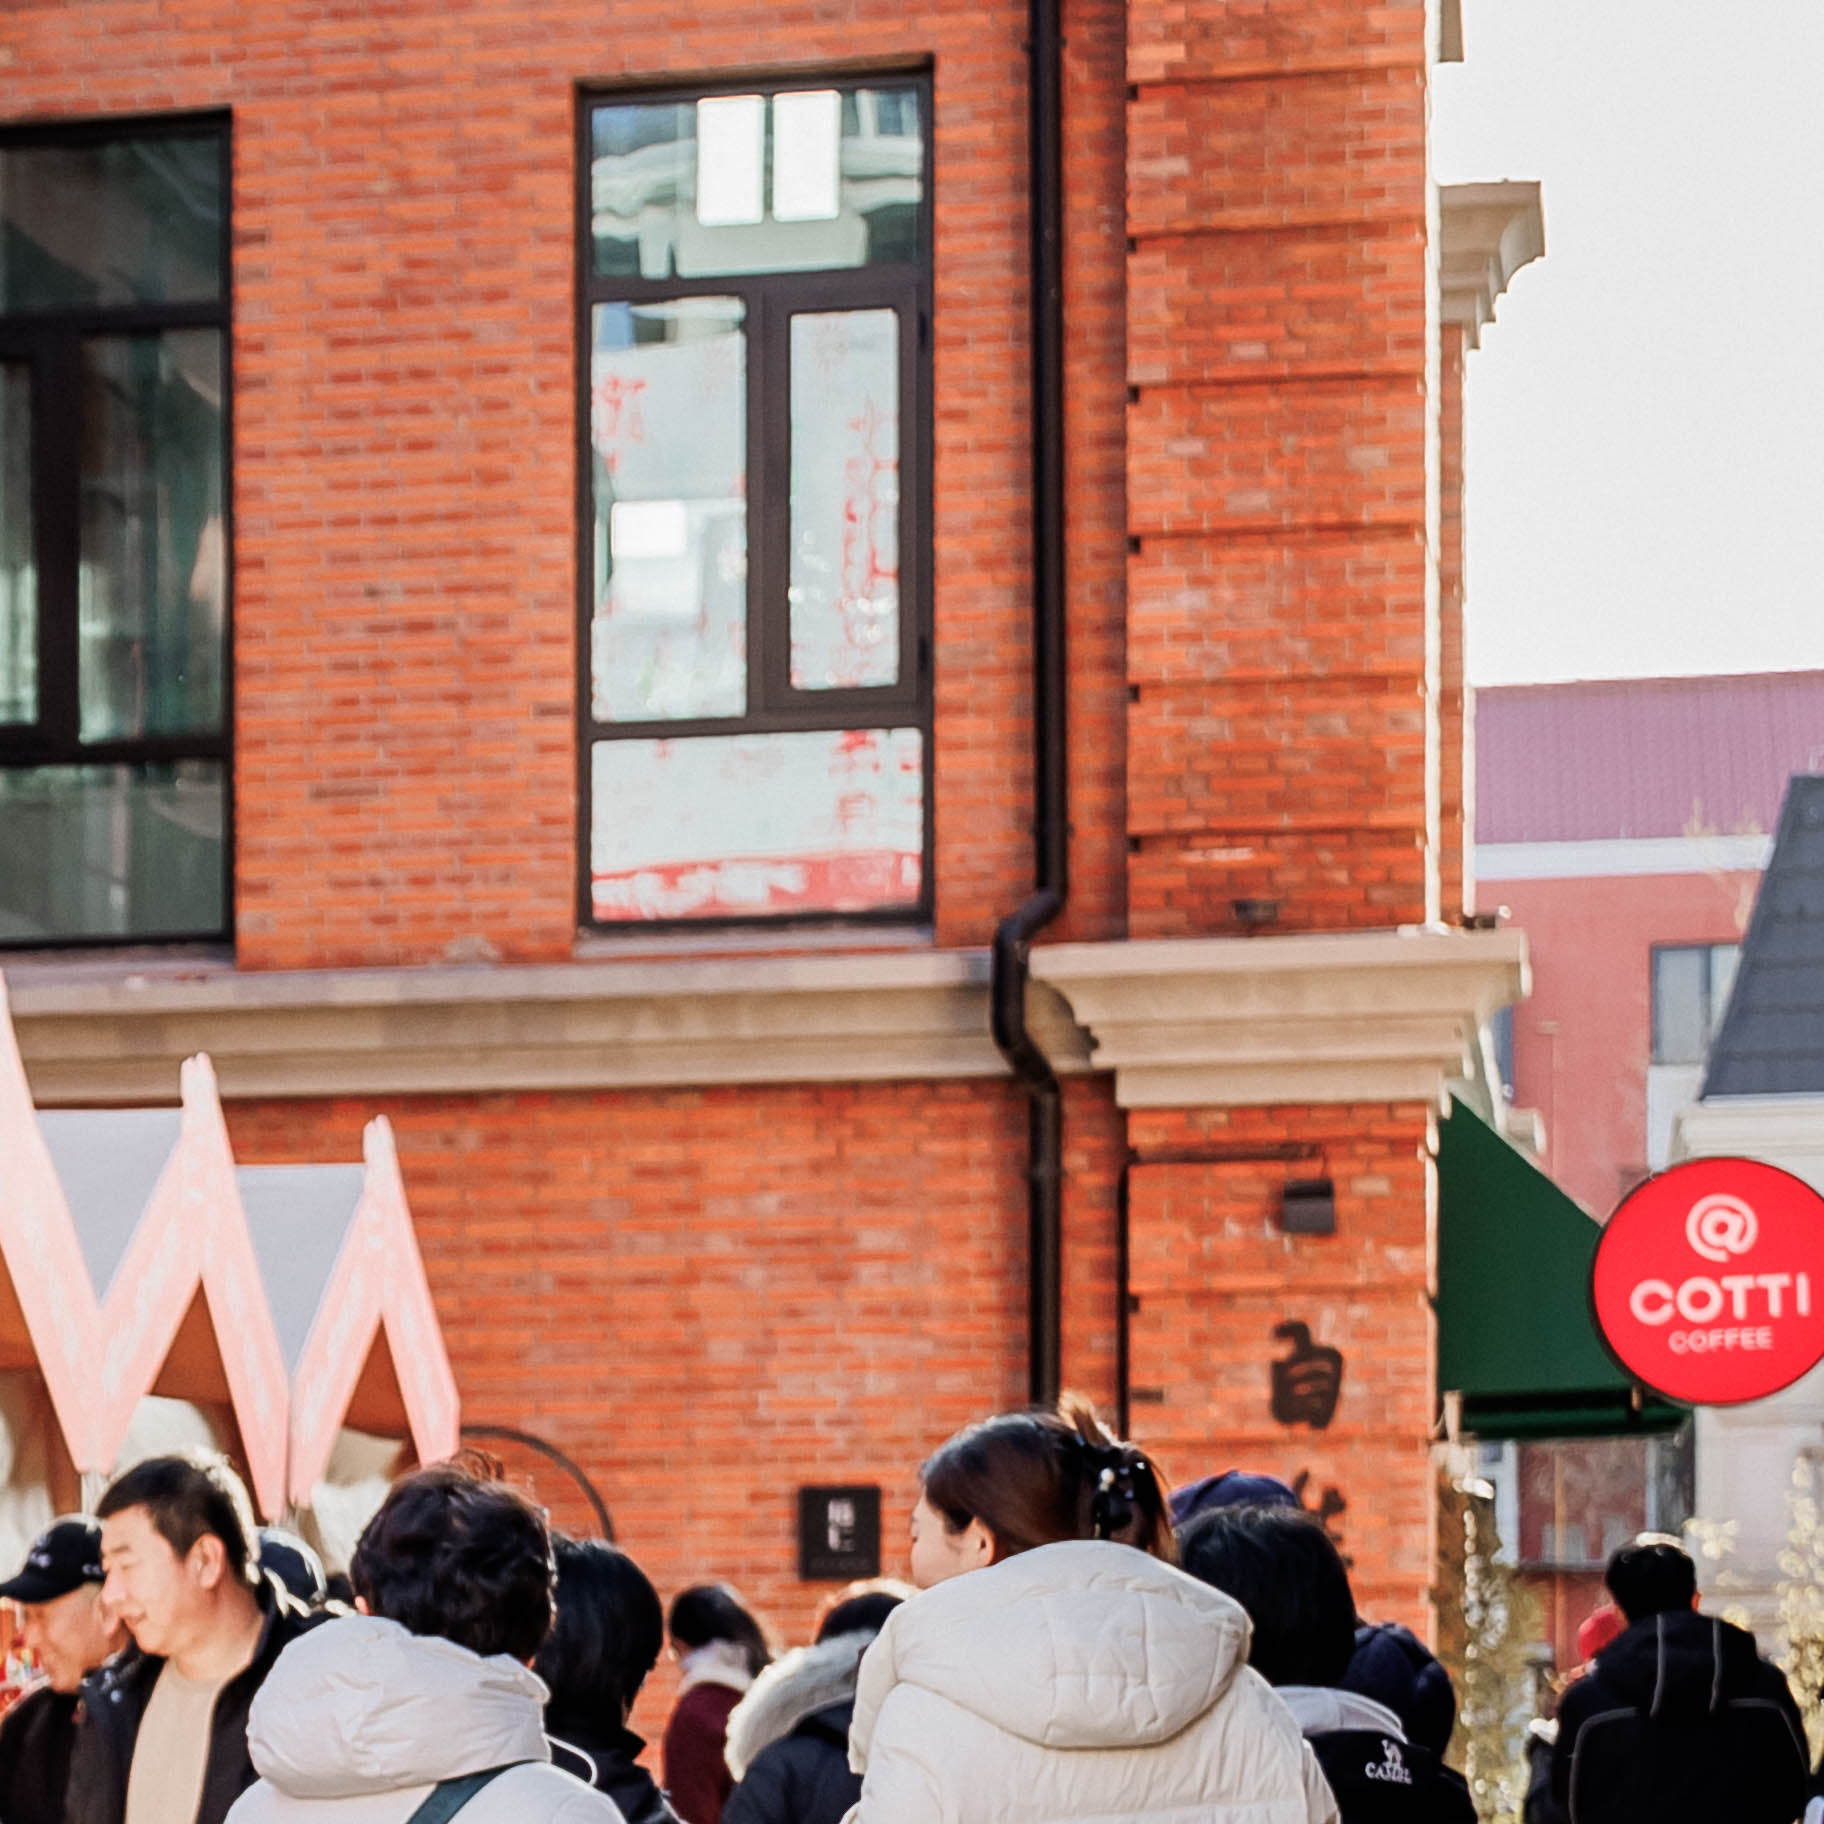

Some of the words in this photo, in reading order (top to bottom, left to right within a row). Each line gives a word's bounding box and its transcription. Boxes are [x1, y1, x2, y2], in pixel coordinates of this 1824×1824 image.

[1629, 1272, 1811, 1326] COTTI
[1668, 1326, 1773, 1354] COFFEE
[1365, 1761, 1412, 1785] CAMEL
